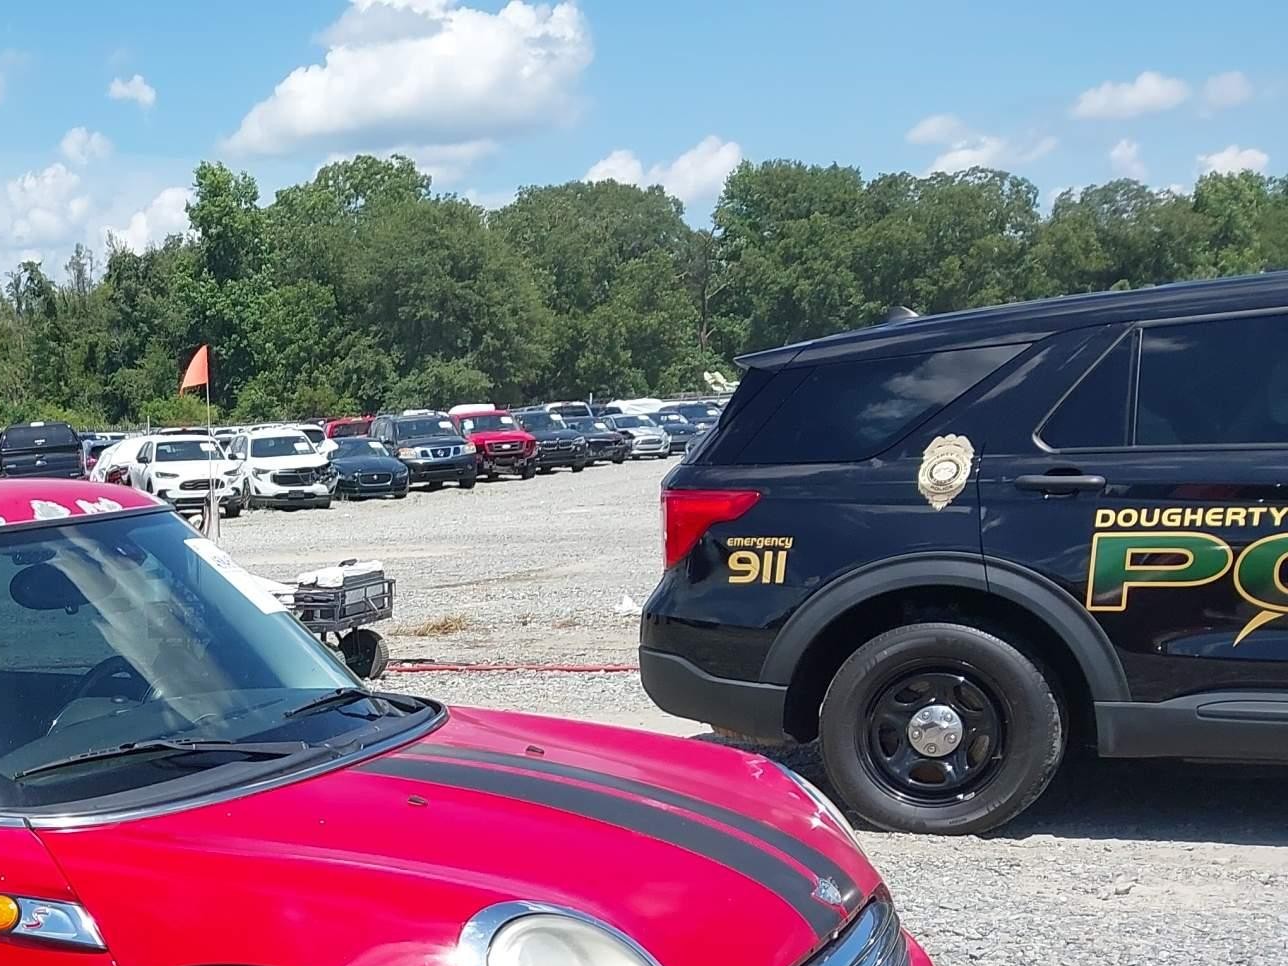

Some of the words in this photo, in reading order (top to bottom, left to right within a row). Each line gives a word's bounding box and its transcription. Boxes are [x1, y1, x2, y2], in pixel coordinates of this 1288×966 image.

[1094, 507, 1288, 528] DOUGHERTY
[727, 537, 793, 549] emergency
[728, 551, 788, 584] 911
